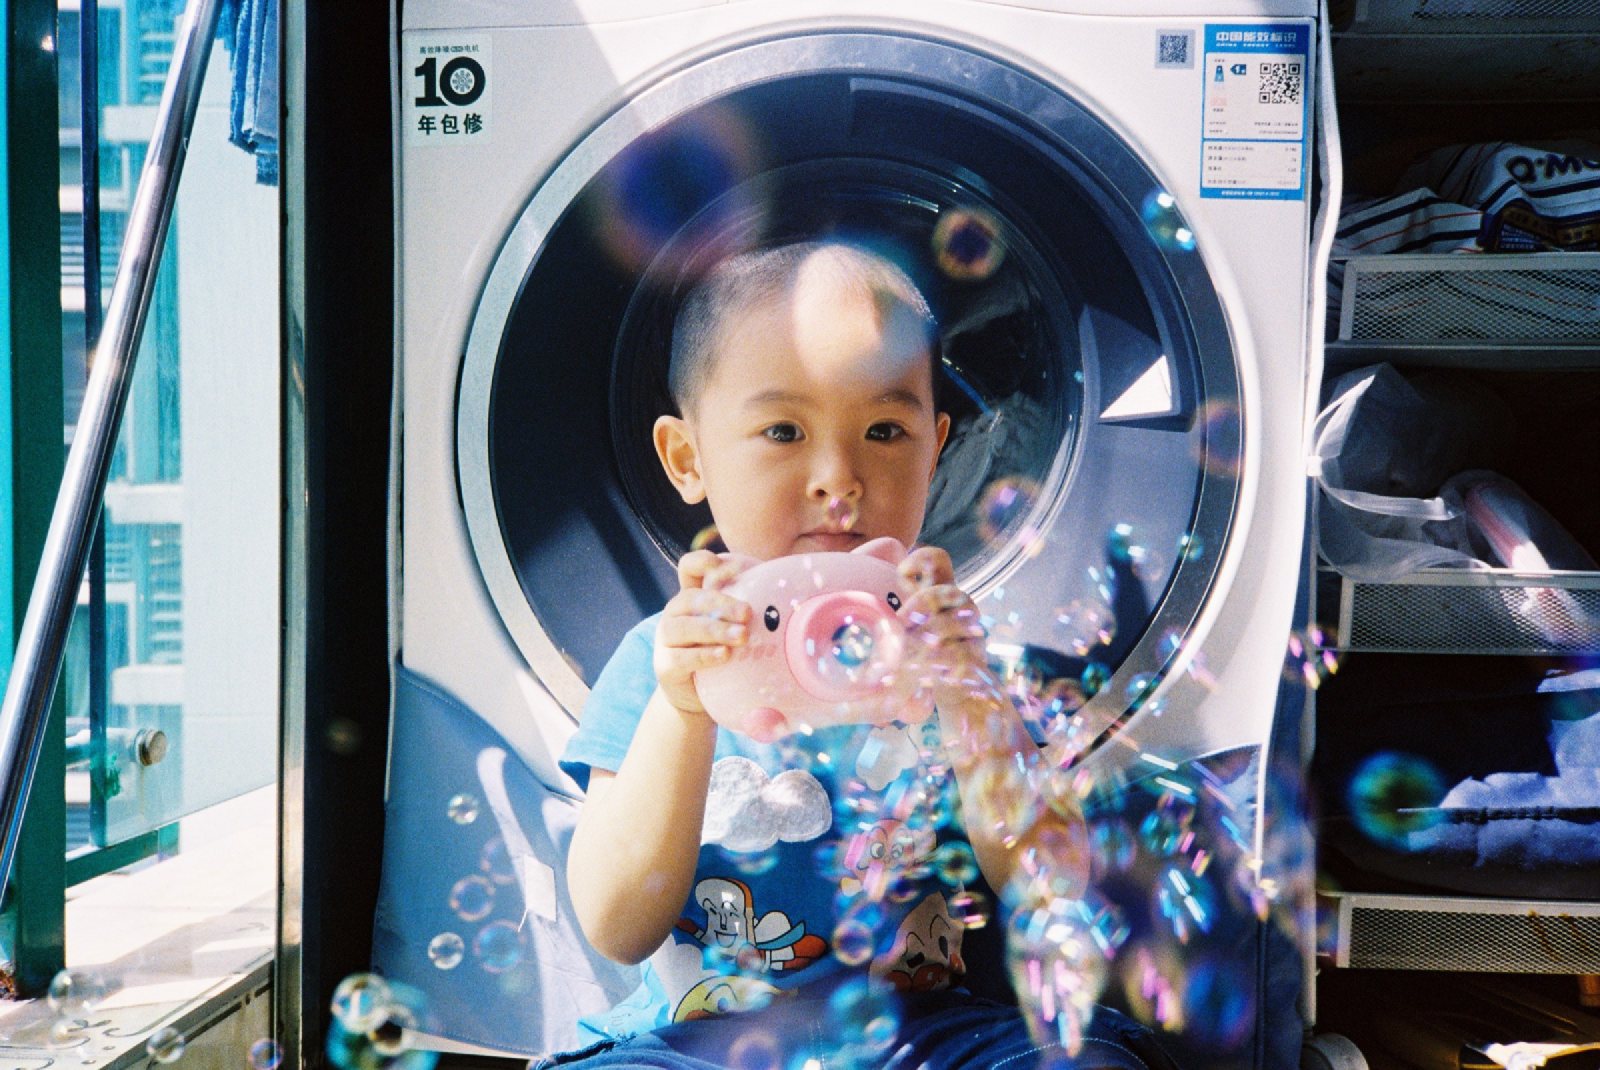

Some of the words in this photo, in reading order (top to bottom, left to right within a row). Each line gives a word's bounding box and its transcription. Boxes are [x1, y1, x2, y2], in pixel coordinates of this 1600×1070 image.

[1215, 32, 1296, 42] 中国能效标识
[415, 56, 486, 107] 10
[417, 113, 483, 136] 年包修
